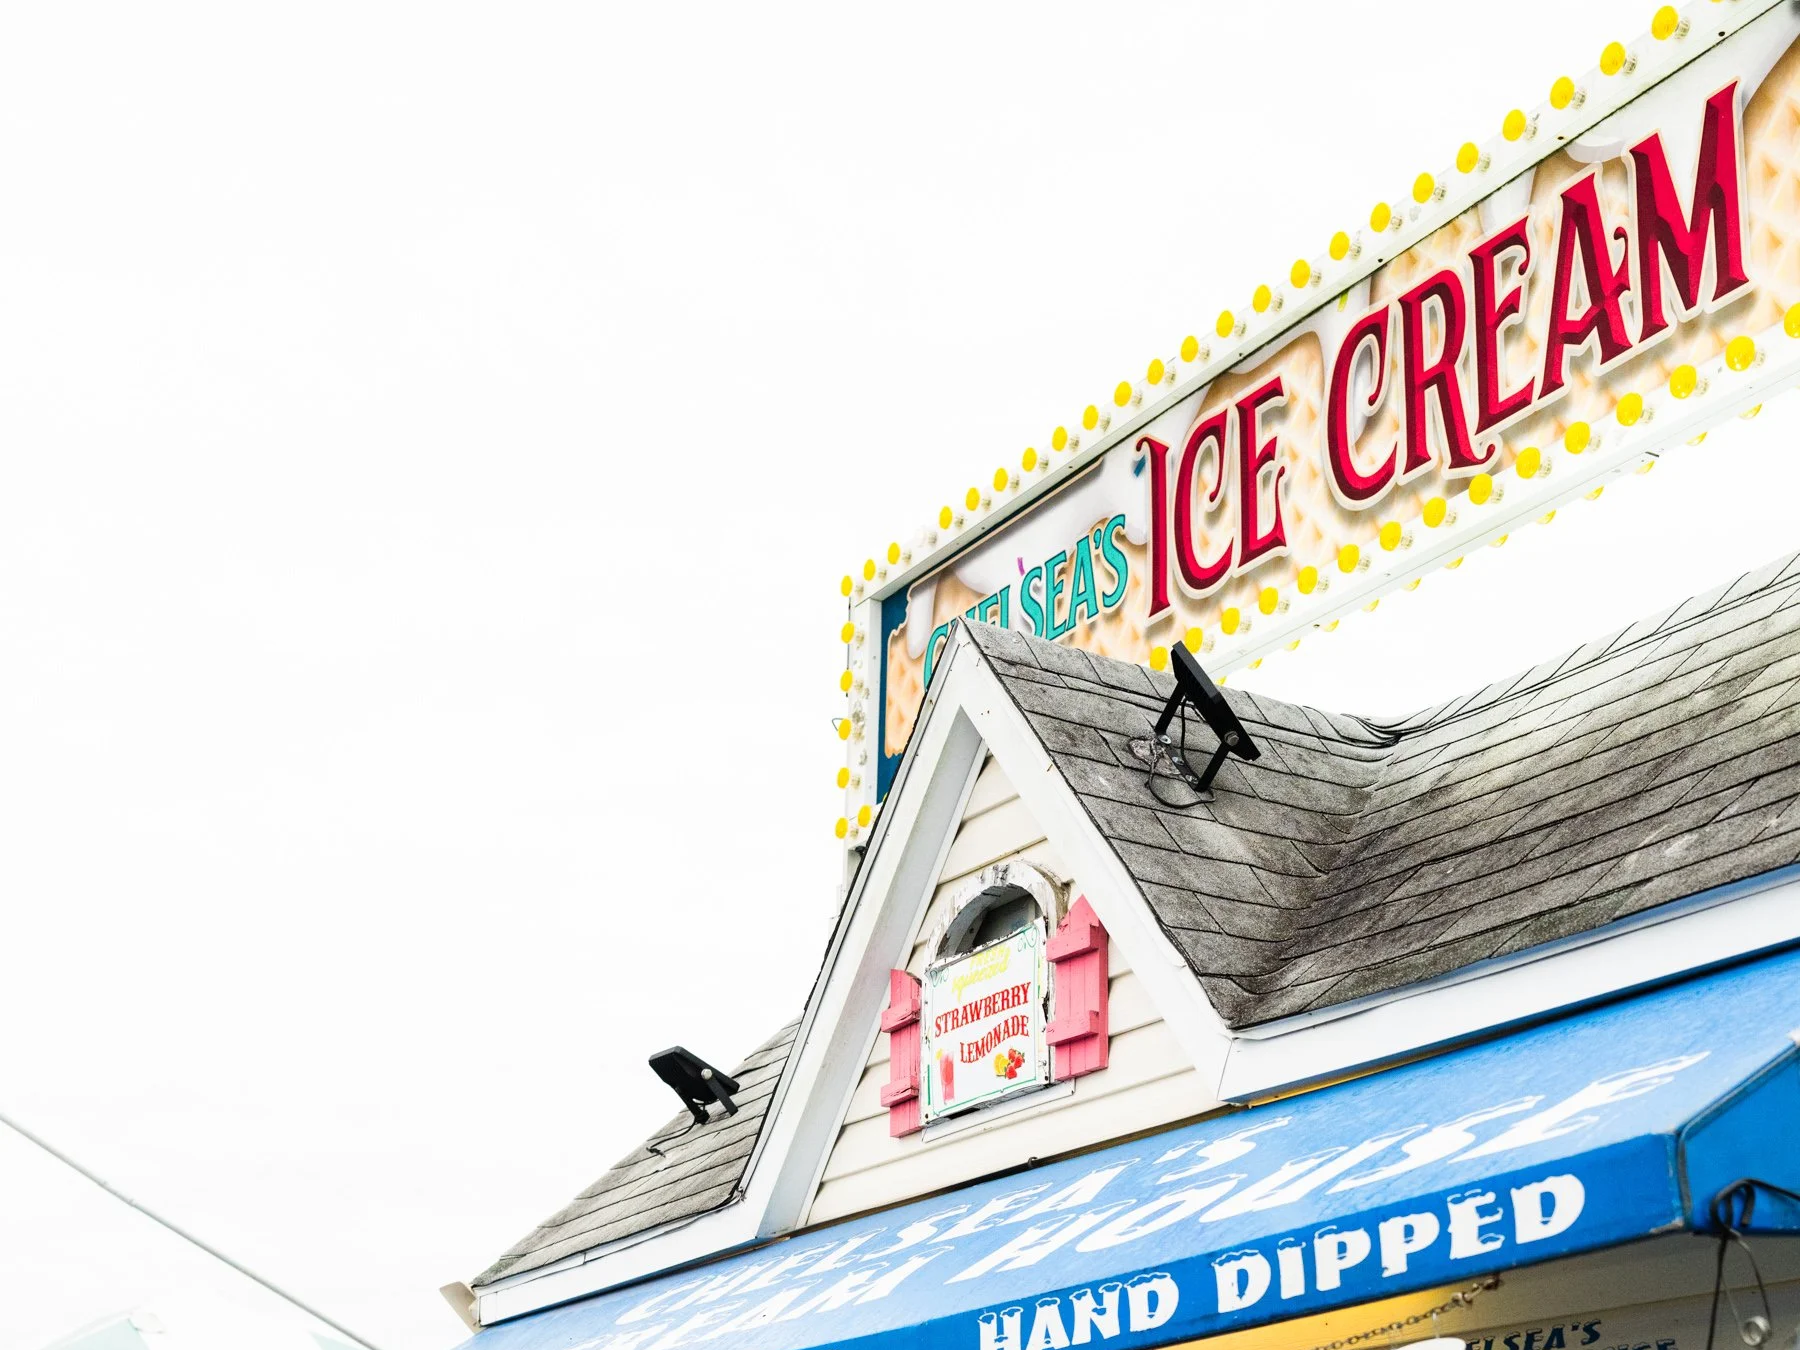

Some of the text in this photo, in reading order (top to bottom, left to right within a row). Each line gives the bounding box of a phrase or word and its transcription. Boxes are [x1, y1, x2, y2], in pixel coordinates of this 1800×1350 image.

[1136, 78, 1750, 616] ICE CREAM
[934, 981, 1032, 1039] STRAWBERRY
[960, 1014, 1030, 1064] LEMONADE
[615, 1116, 1292, 1327] CHELSEA'S
[945, 1050, 1711, 1285] HOUSE
[1211, 1173, 1587, 1313] DIPPED
